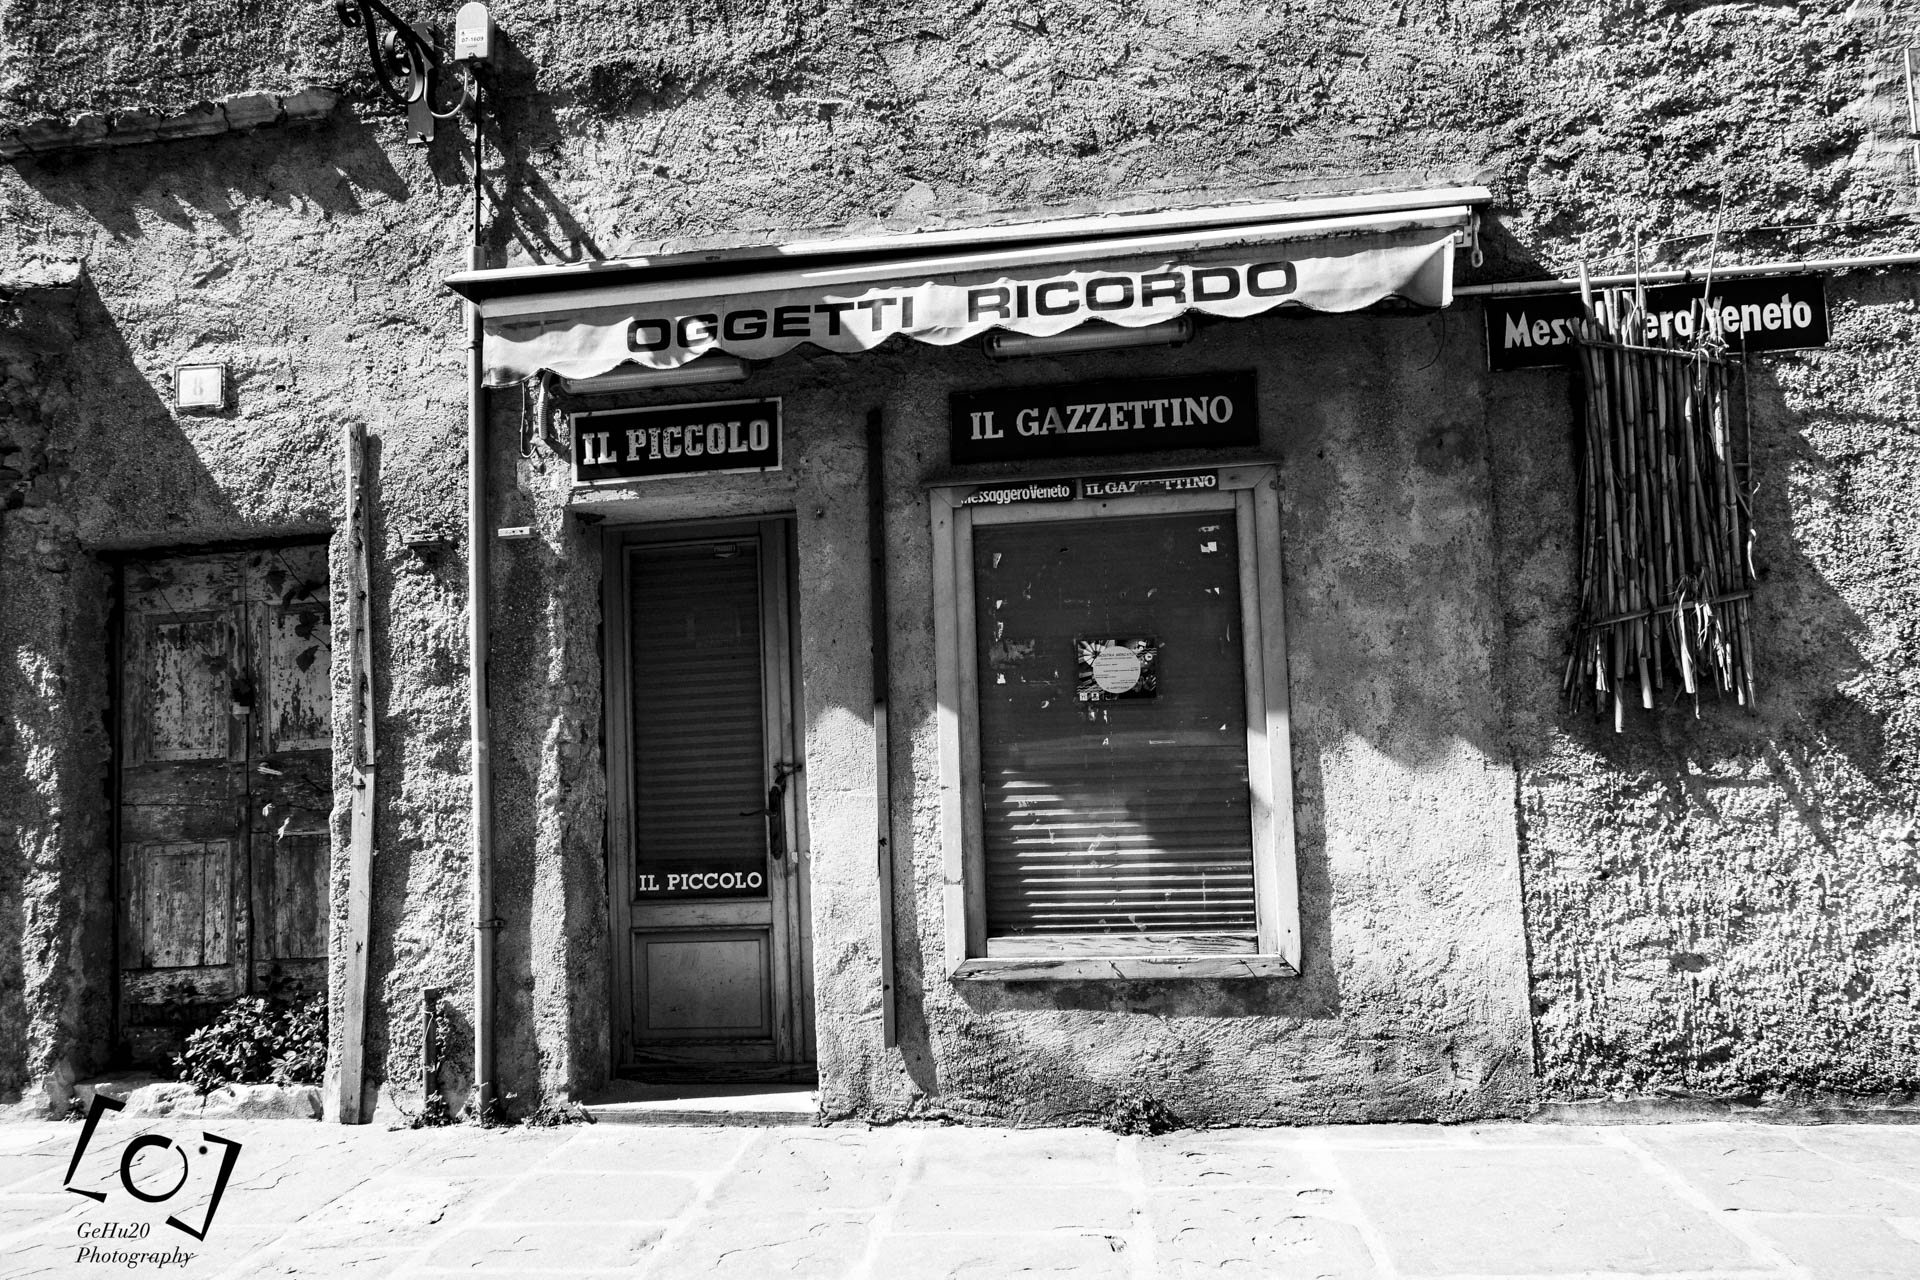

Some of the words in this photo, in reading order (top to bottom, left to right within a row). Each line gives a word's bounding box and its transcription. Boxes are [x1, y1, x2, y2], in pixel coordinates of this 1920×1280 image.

[626, 295, 914, 352] OGGETTI
[967, 261, 1297, 322] RICORDO
[970, 412, 1003, 440] IL
[1016, 395, 1232, 436] GAZZETTINO
[582, 432, 617, 465] IL
[626, 419, 768, 461] PICCOLO
[1085, 484, 1103, 495] IL
[639, 874, 659, 890] IL
[667, 871, 762, 890] PICCOLO
